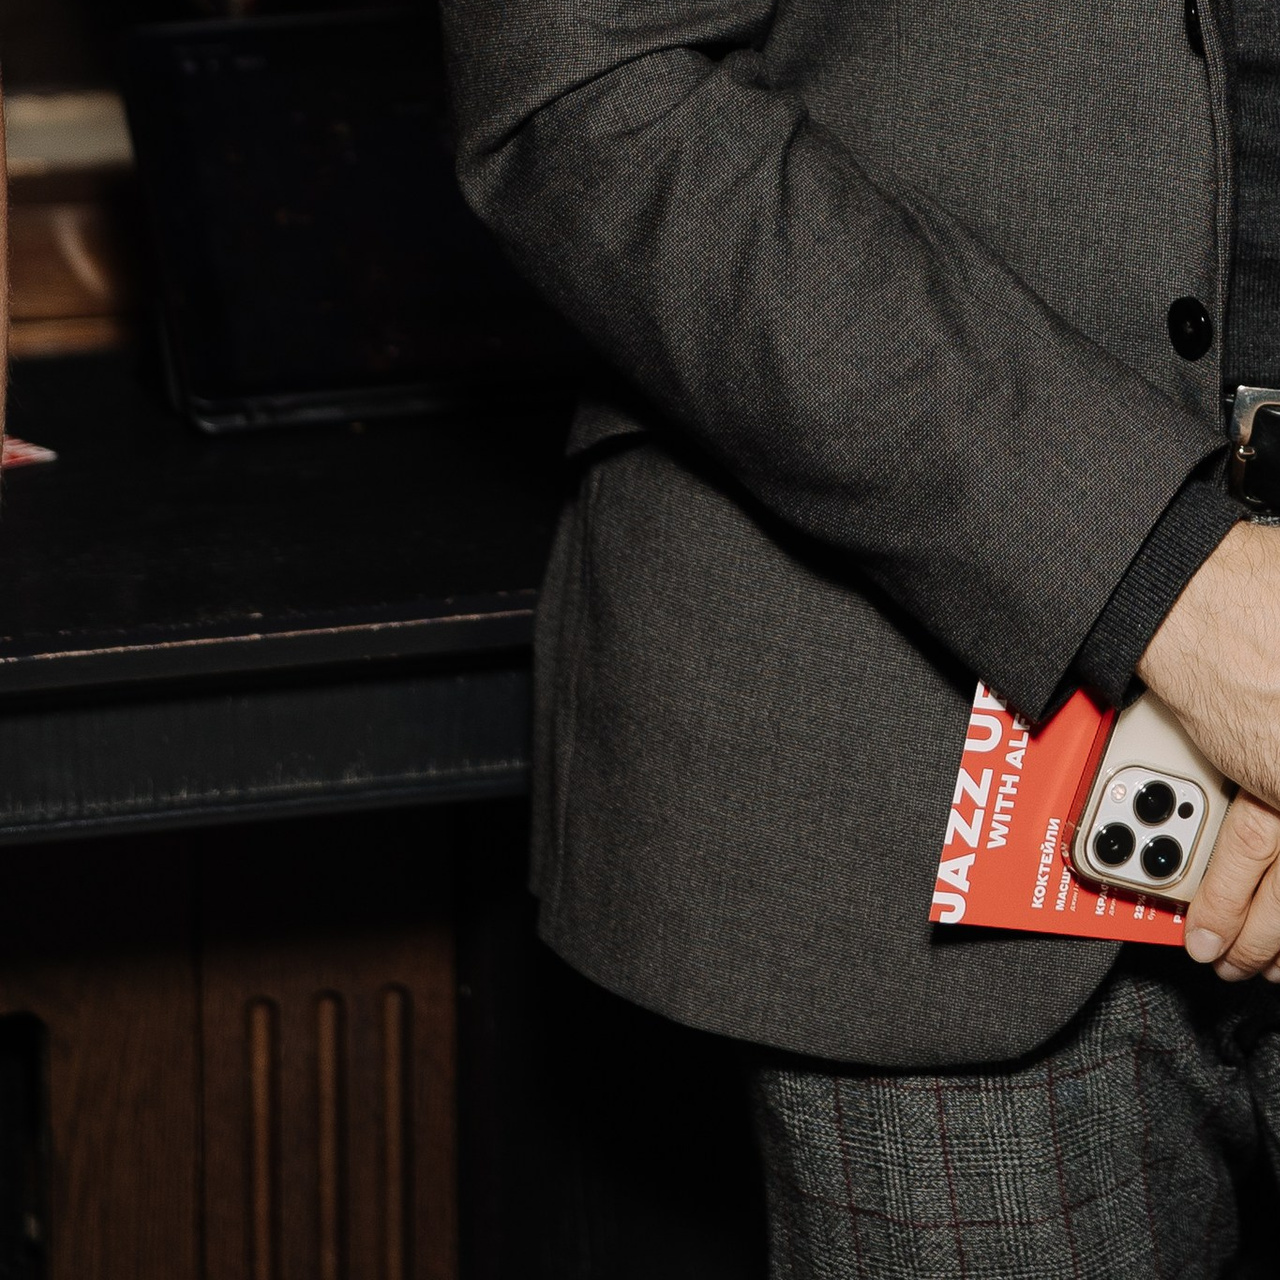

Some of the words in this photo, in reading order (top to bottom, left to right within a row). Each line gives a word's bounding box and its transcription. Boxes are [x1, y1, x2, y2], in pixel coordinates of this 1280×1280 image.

[932, 768, 994, 924] JAZZ
[986, 773, 1020, 850] WITH
[1031, 817, 1061, 910] КОКТЕЙЛИ
